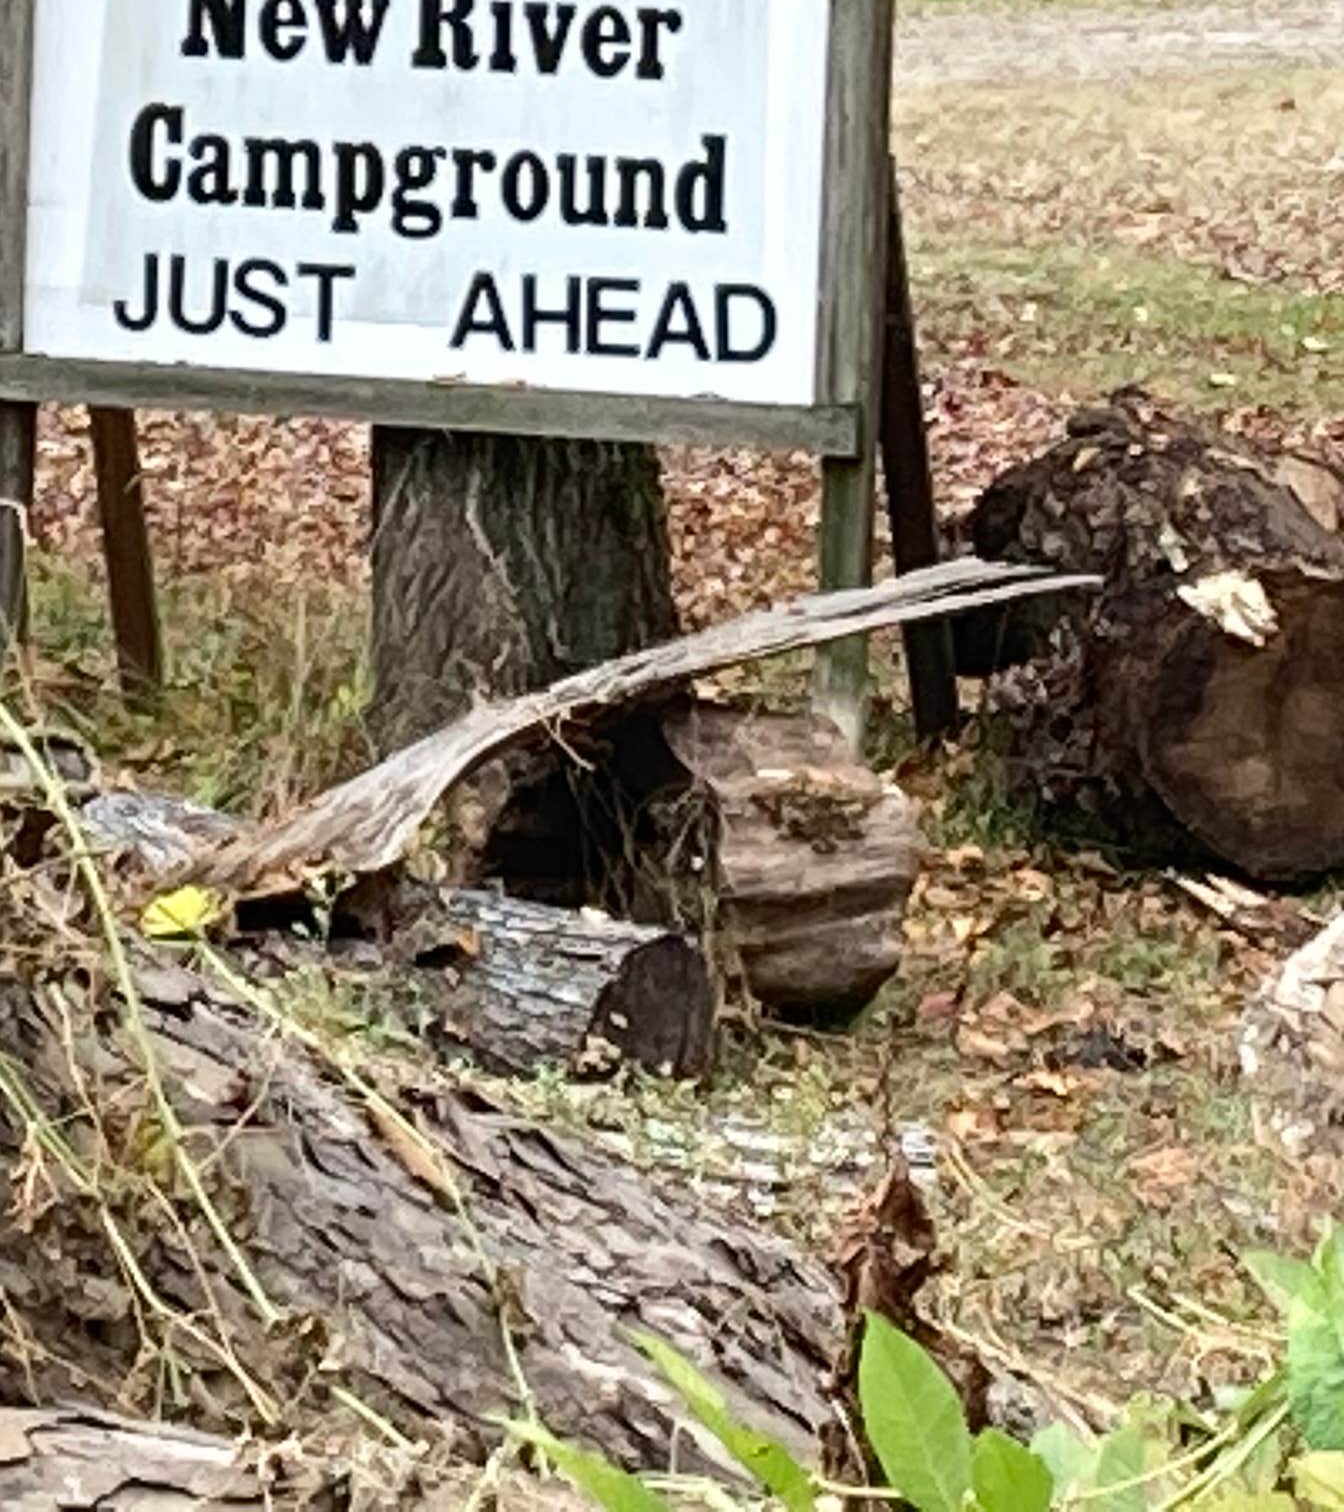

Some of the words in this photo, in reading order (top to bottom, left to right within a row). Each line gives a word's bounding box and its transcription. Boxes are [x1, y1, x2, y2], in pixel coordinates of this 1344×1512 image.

[128, 101, 728, 240] Campground
[112, 252, 357, 343] JUST
[448, 270, 778, 364] AHEAD
